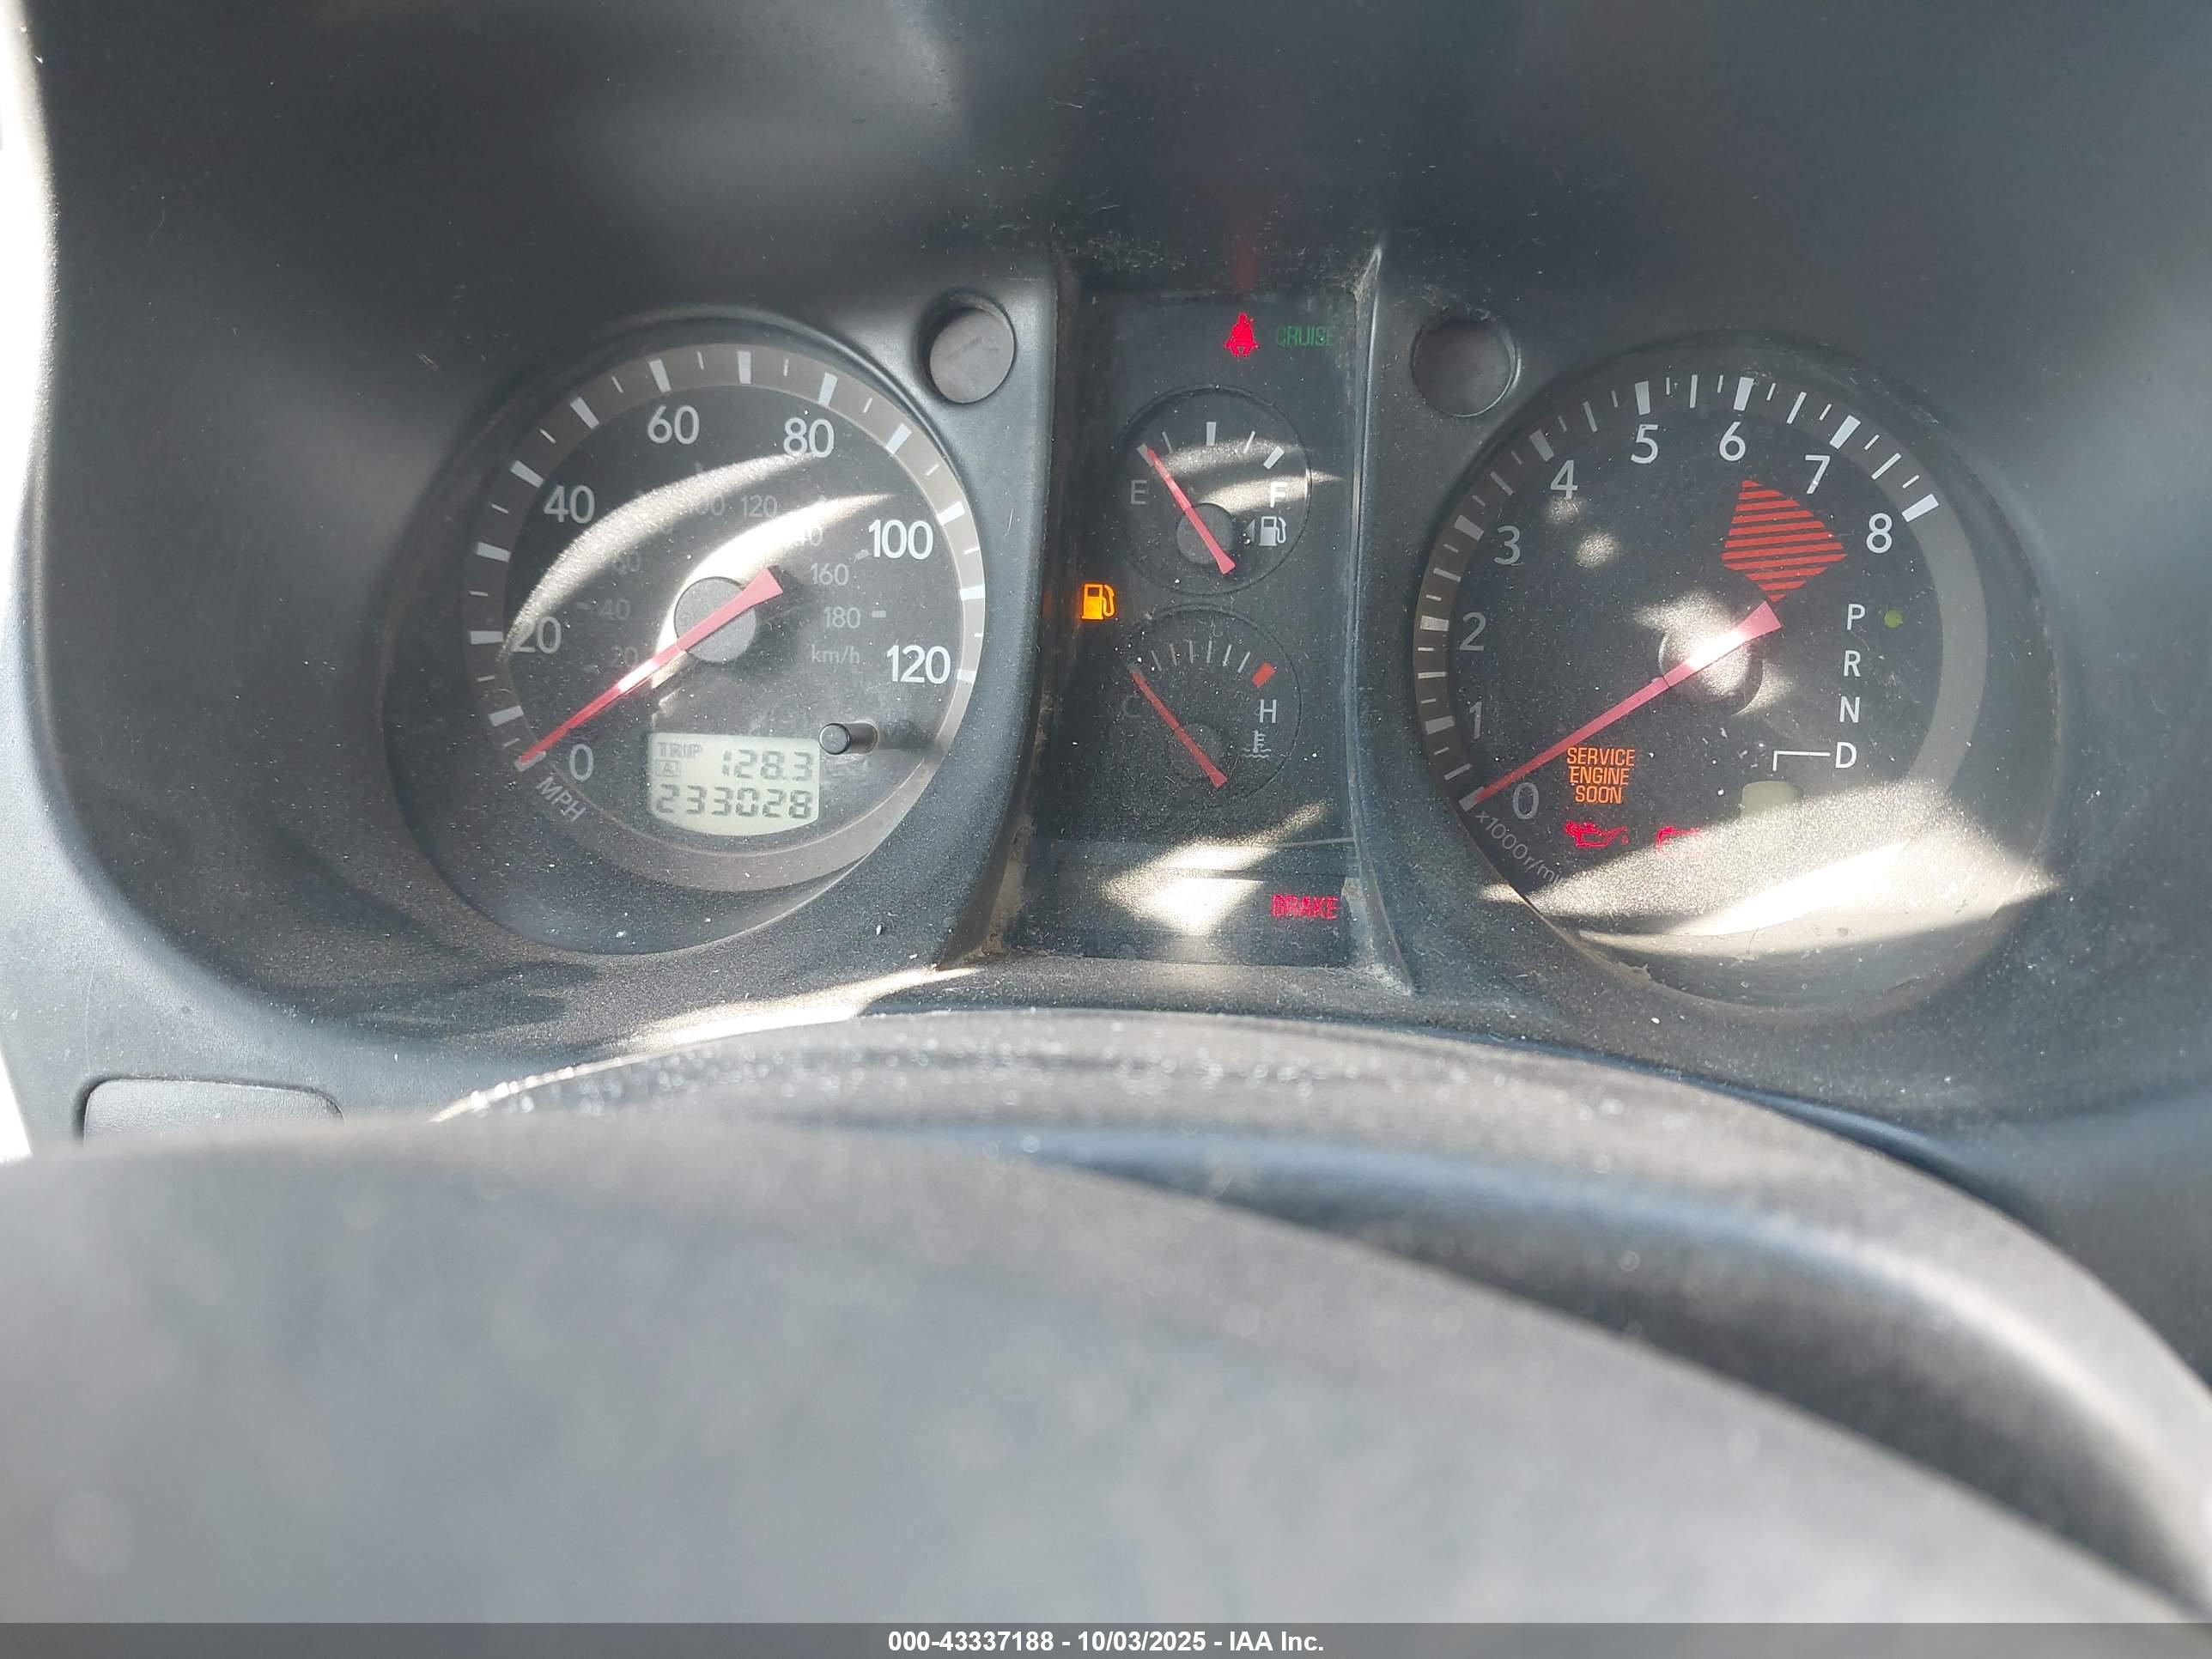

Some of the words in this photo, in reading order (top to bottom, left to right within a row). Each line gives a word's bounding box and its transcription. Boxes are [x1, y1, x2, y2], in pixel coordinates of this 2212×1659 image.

[647, 405, 700, 444] 60
[783, 417, 835, 458] 80
[1718, 422, 1746, 461] 6
[1632, 423, 1658, 464] 5
[1551, 459, 1578, 499] 4
[1805, 455, 1830, 494] 7
[544, 484, 595, 525] 40
[740, 494, 778, 518] 120
[1130, 479, 1147, 506] E
[1270, 482, 1288, 507] F
[867, 519, 933, 560] 100
[1494, 526, 1521, 565] 3
[1866, 513, 1893, 554] 8
[810, 562, 849, 586] 160
[823, 606, 861, 629] 180
[1461, 611, 1486, 652] 2
[1846, 604, 1866, 631] P
[512, 617, 562, 654] 20
[810, 643, 860, 665] km/h
[886, 645, 952, 686] 120
[1844, 650, 1861, 678] R
[1259, 699, 1277, 723] H
[1469, 701, 1484, 740] 1
[1839, 696, 1860, 723] N
[569, 744, 594, 781] 0
[658, 742, 702, 758] TRIP
[1566, 747, 1635, 767] SERVICE
[1835, 741, 1857, 769] D
[1569, 766, 1630, 785] ENGINE
[536, 775, 586, 823] MPH
[656, 784, 812, 818] 233028
[1512, 781, 1540, 820] 0
[1575, 785, 1621, 804] SOON
[1271, 894, 1338, 920] BRAKE
